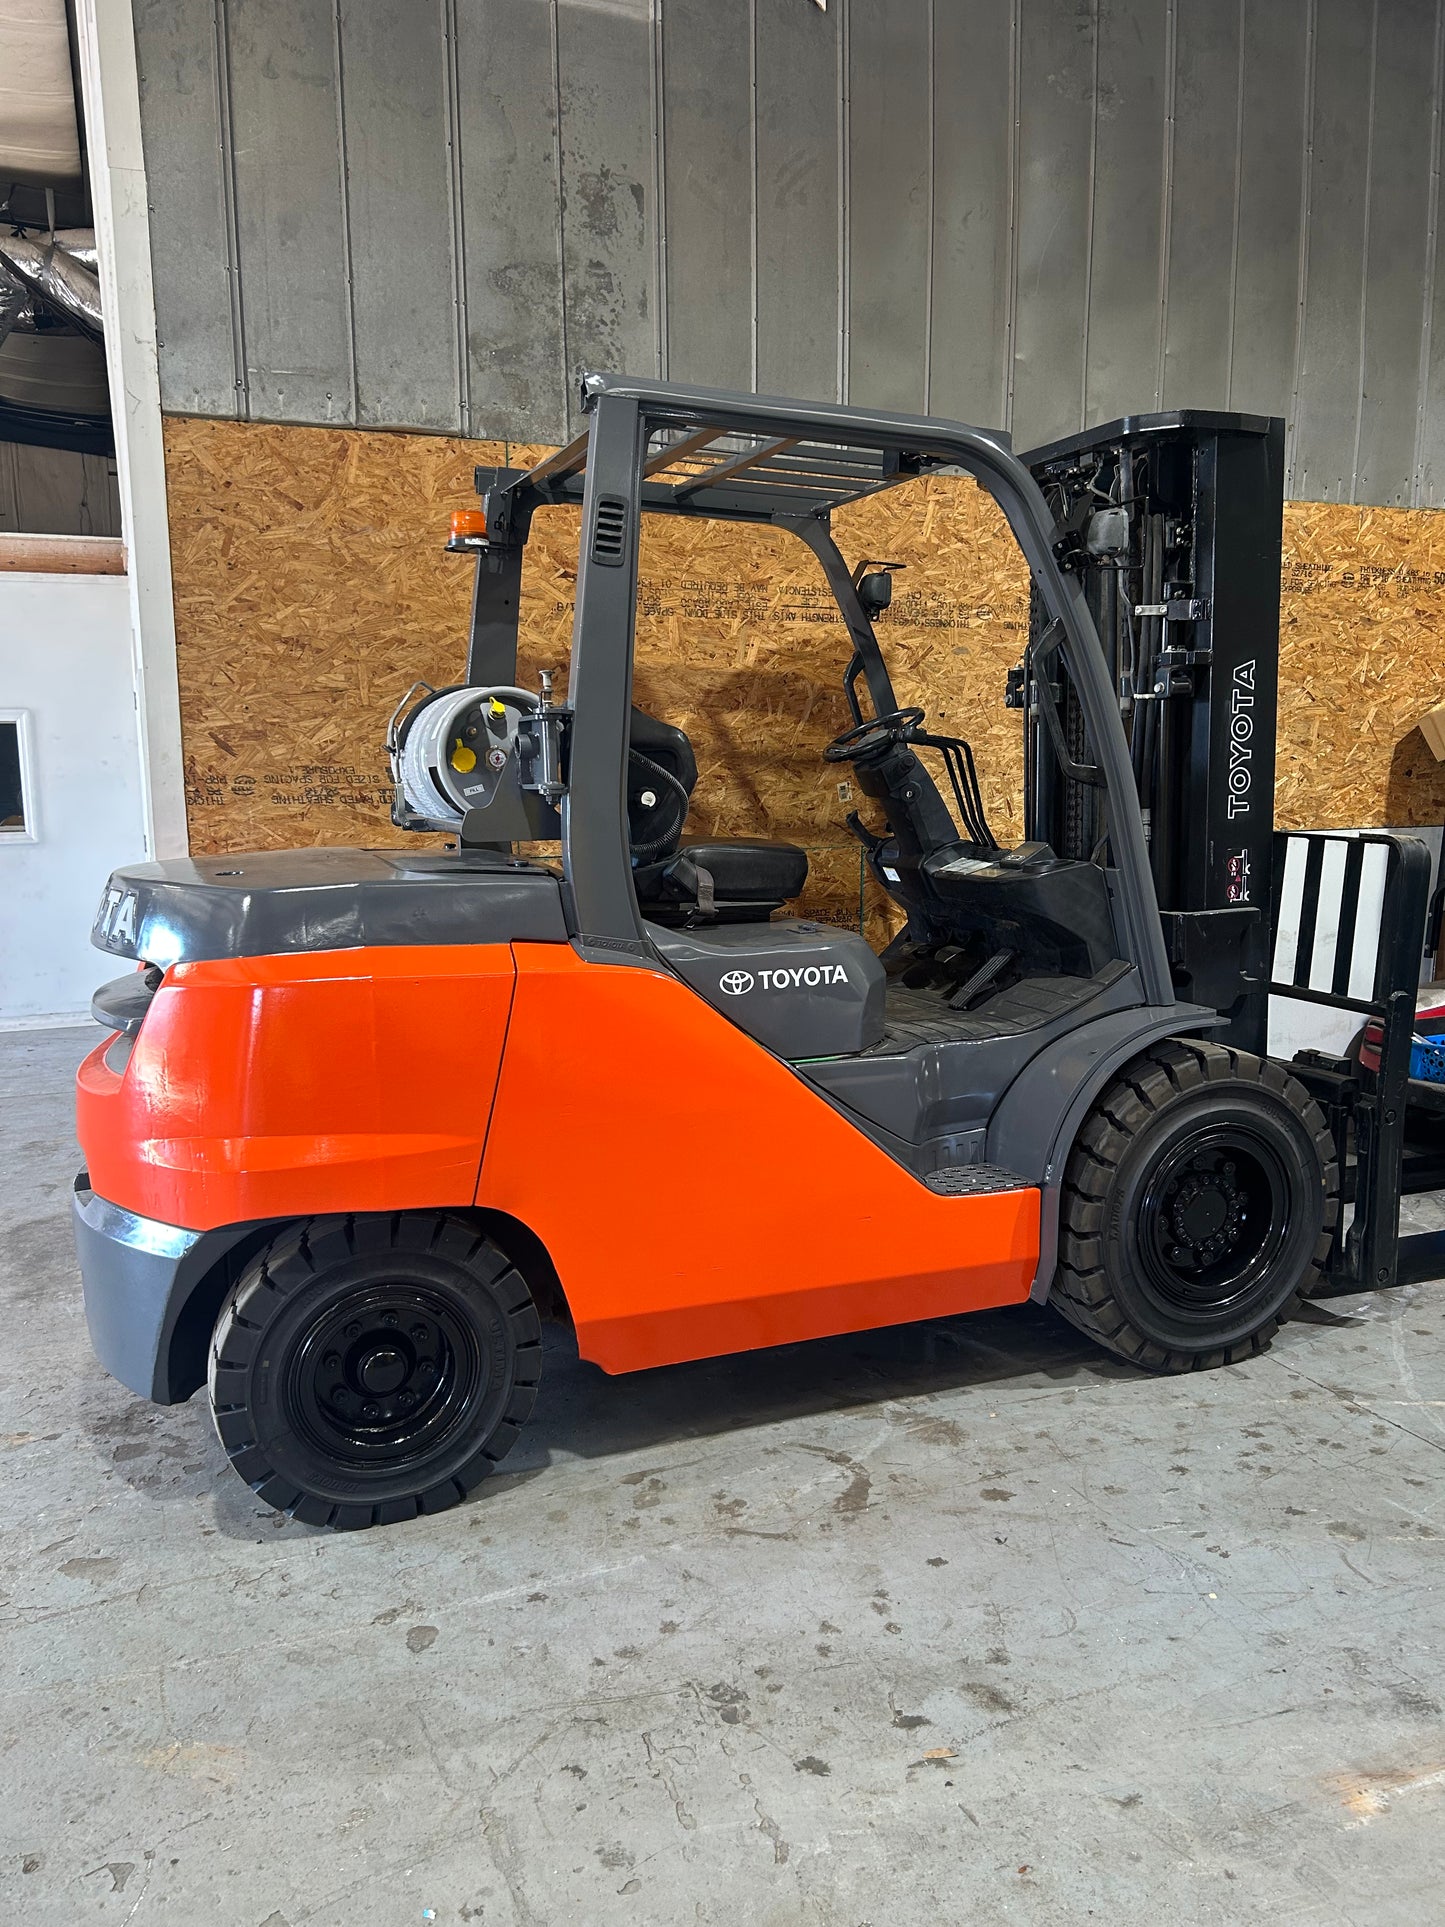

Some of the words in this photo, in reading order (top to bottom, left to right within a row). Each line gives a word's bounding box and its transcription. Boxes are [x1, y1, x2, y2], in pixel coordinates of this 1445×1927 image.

[680, 580, 728, 591] REQUIRED
[733, 583, 745, 592] BE
[750, 584, 769, 593] MAY
[778, 586, 834, 597] ESISTENCIA
[684, 609, 709, 619] DOWN
[713, 609, 738, 620] SIDE
[742, 611, 765, 621] THIS
[773, 612, 797, 621] AXIS
[801, 613, 846, 623] STRENGTH
[1228, 659, 1256, 819] TOYOTA
[301, 766, 355, 775] EXPOSURE
[263, 775, 313, 784] SPACING
[319, 774, 340, 784] FOR
[346, 775, 380, 784] SIZED
[271, 795, 334, 804] SHEATHING
[758, 964, 849, 990] TOYOTA
